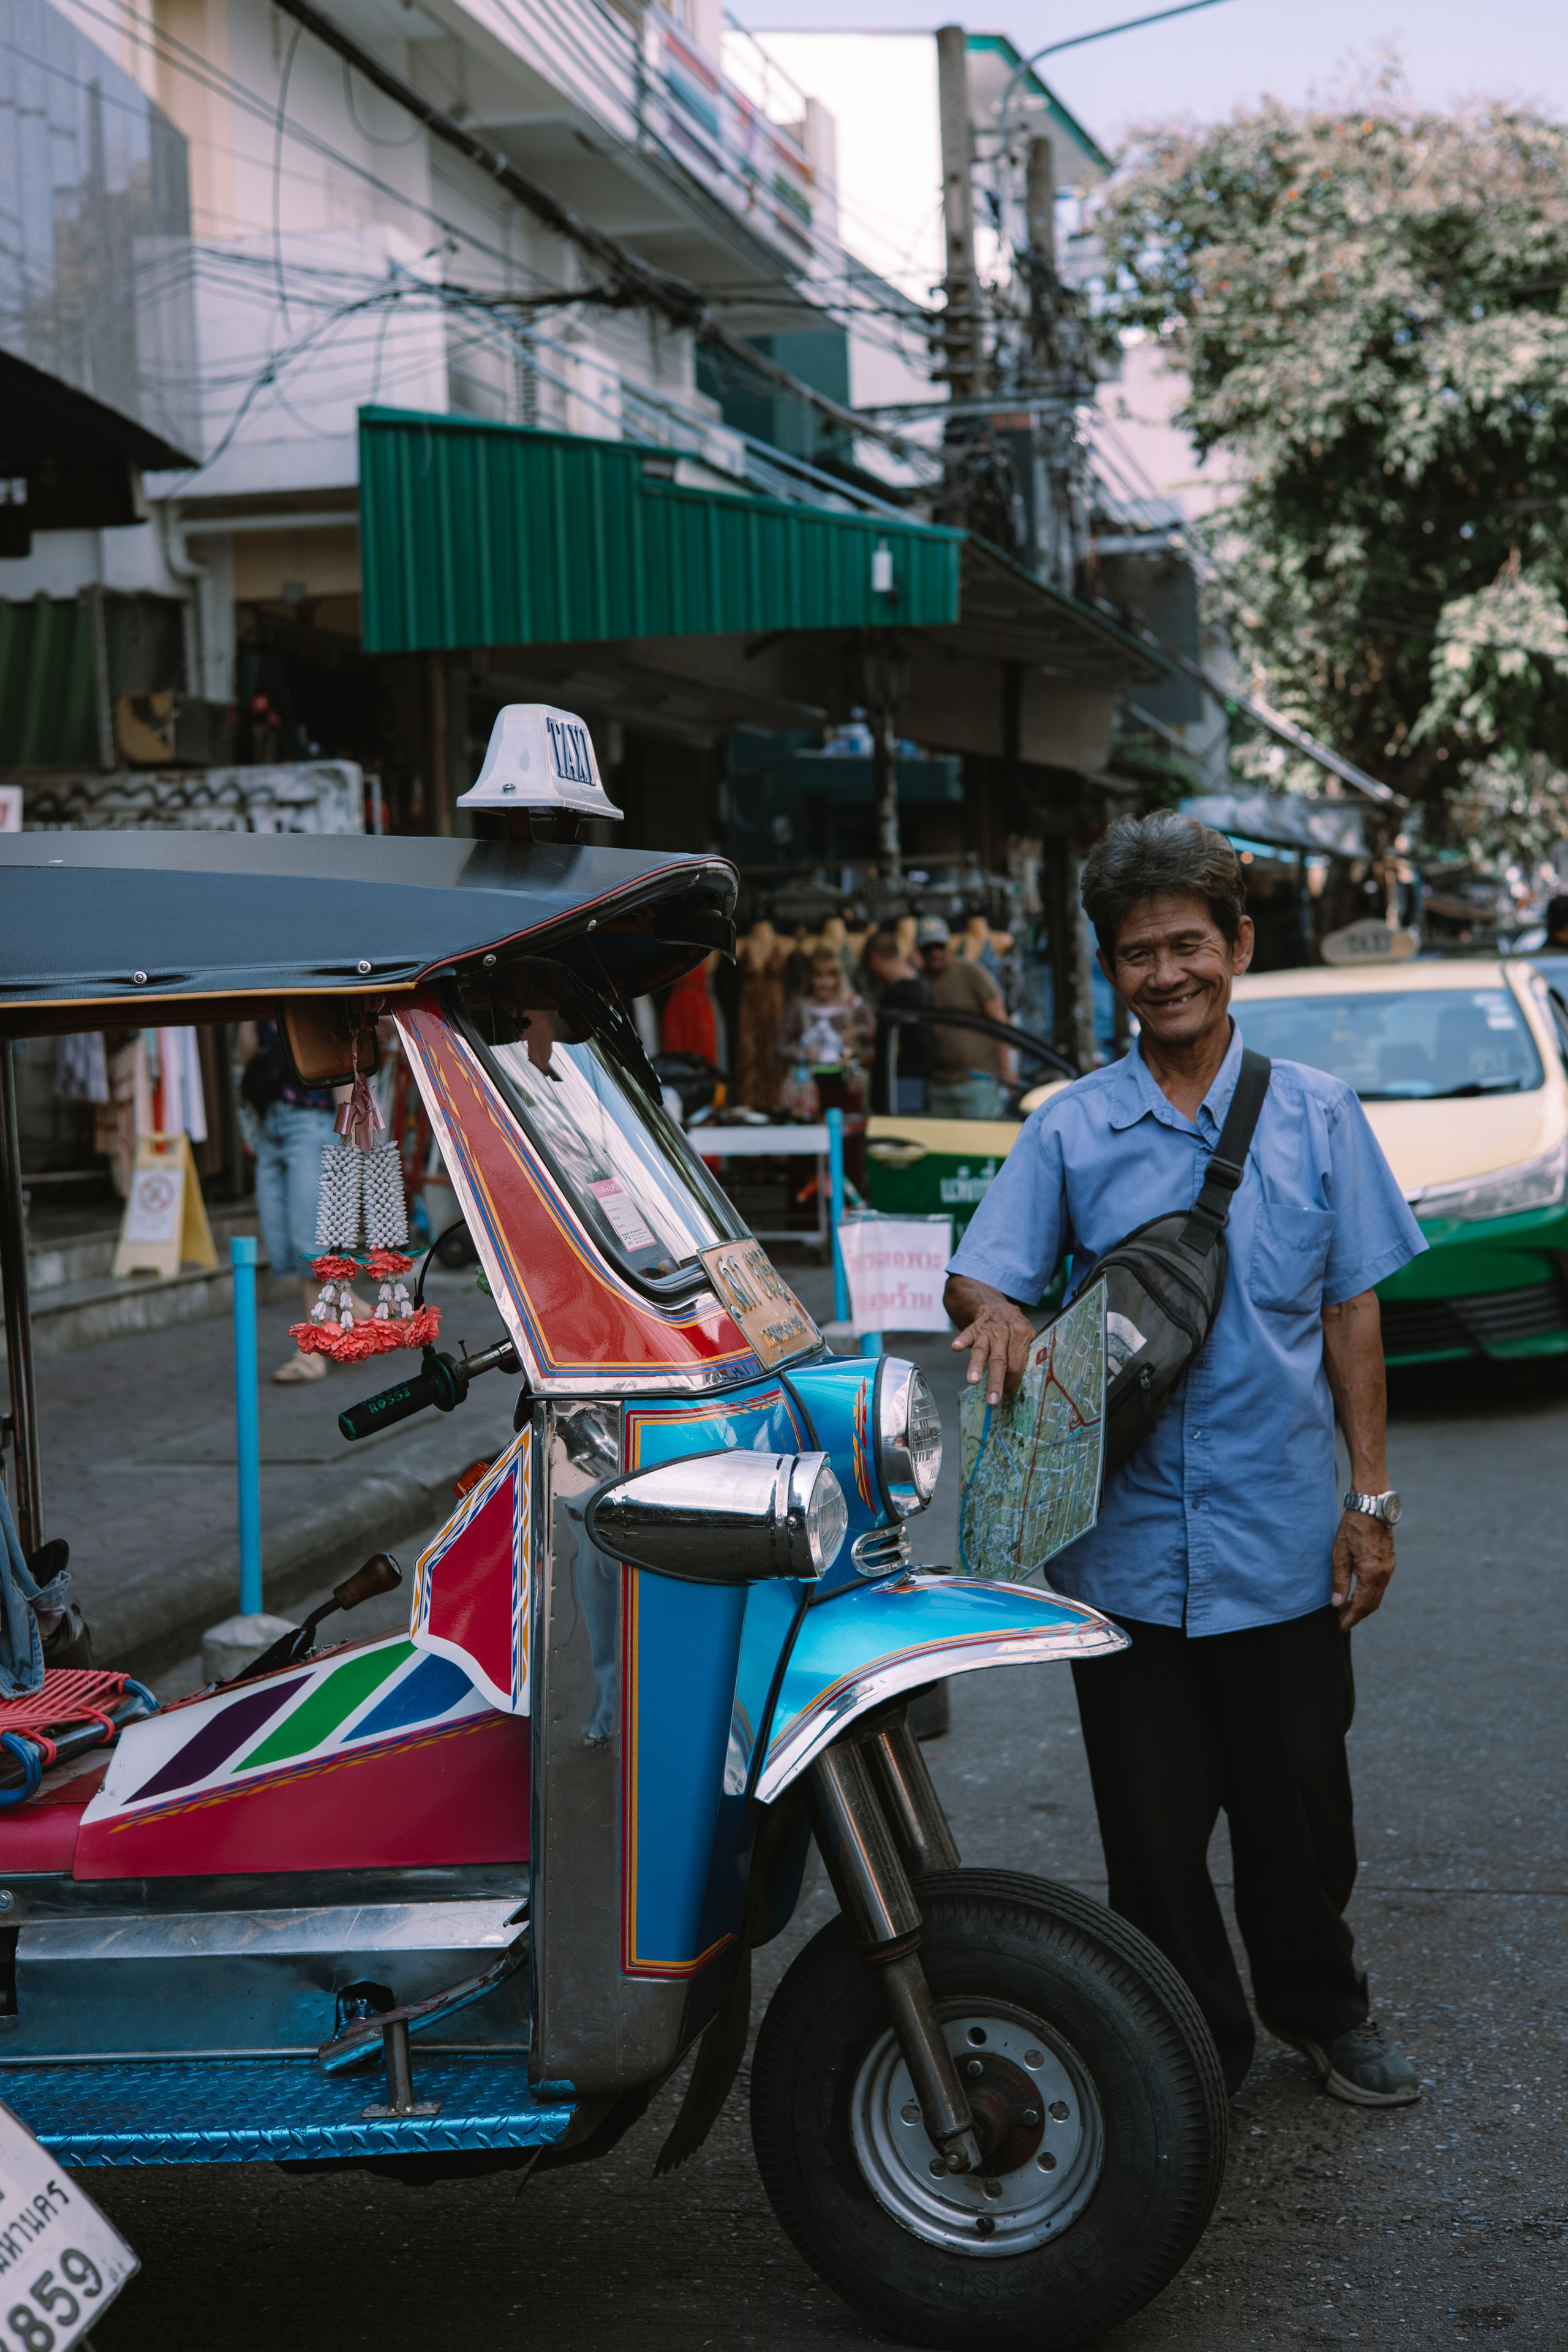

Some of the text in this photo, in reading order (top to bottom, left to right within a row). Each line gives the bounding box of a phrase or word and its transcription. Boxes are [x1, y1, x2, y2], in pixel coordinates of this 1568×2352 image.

[546, 717, 597, 786] TAXI
[608, 1182, 620, 1192] LPG
[368, 1387, 410, 1414] ROSSI
[0, 2247, 103, 2352] 859
